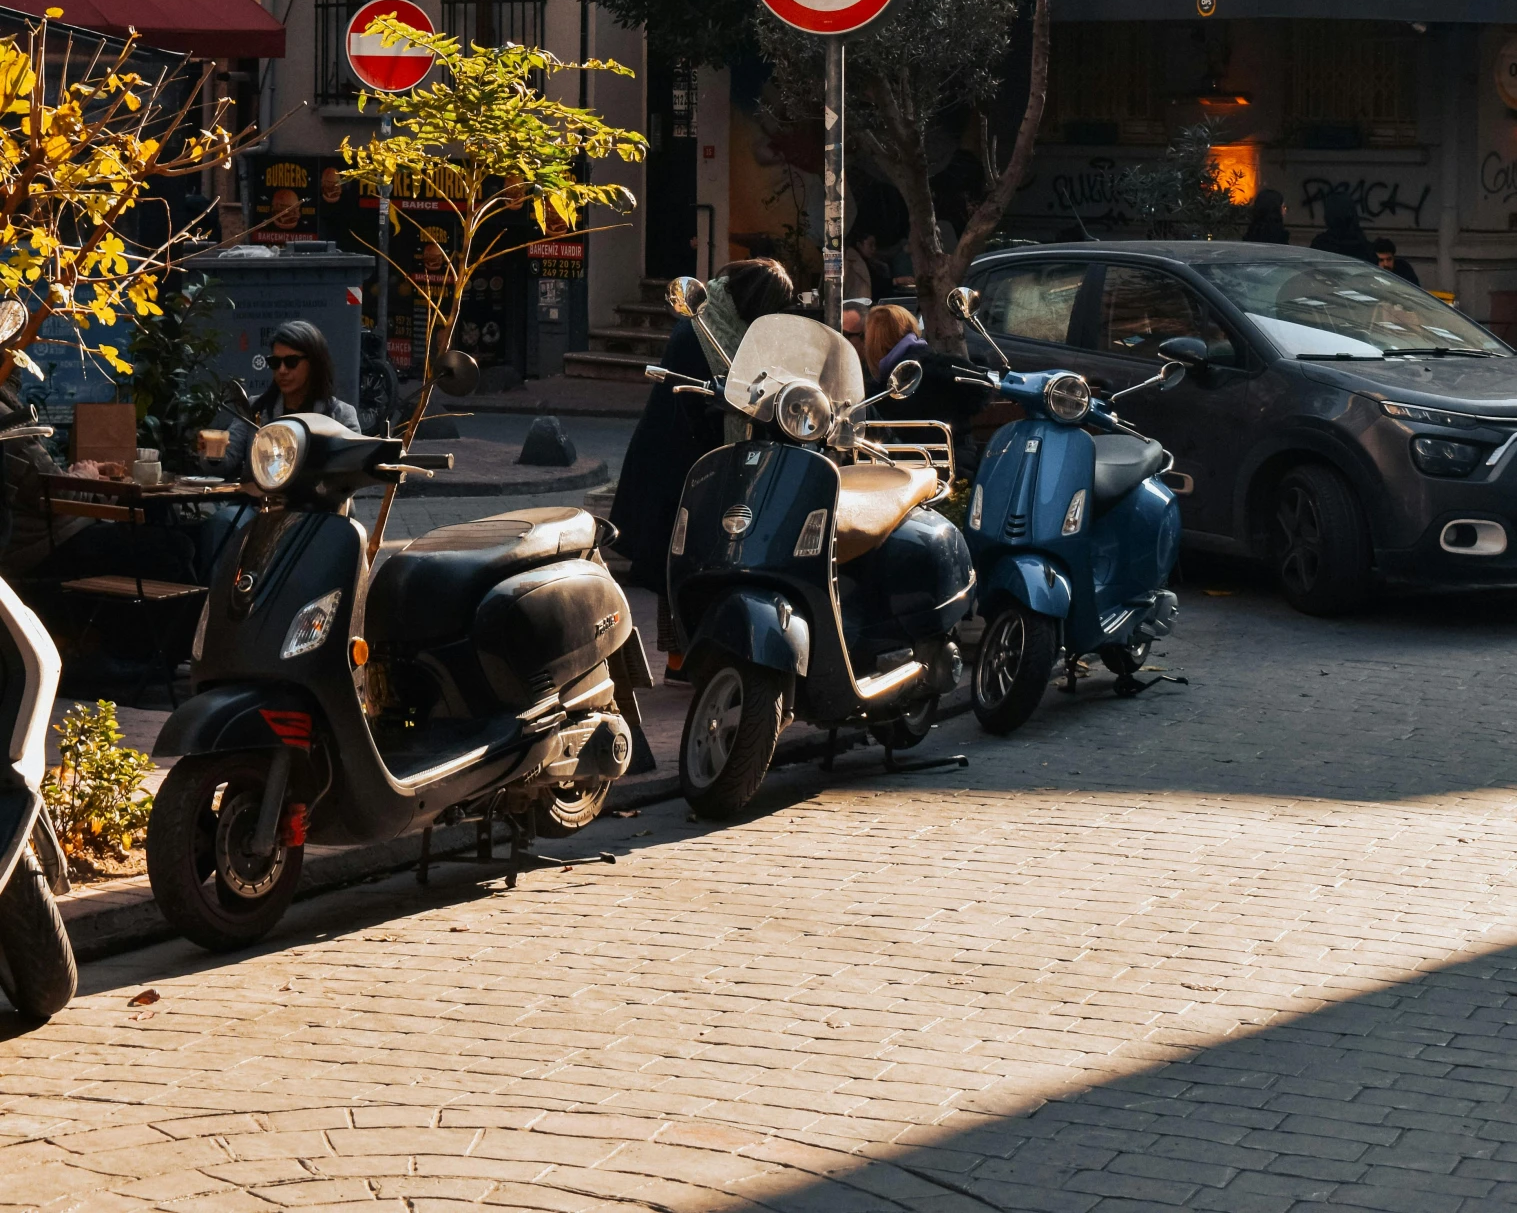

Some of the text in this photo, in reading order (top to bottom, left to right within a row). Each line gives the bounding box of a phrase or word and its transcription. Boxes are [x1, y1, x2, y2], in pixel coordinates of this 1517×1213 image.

[265, 162, 308, 189] BURGERS
[402, 200, 439, 210] BAHÇE
[530, 243, 582, 258] BAHÇEMİZ VARDIR
[542, 260, 581, 270] 957 20 75
[542, 269, 557, 277] 249
[559, 270, 569, 278] 72
